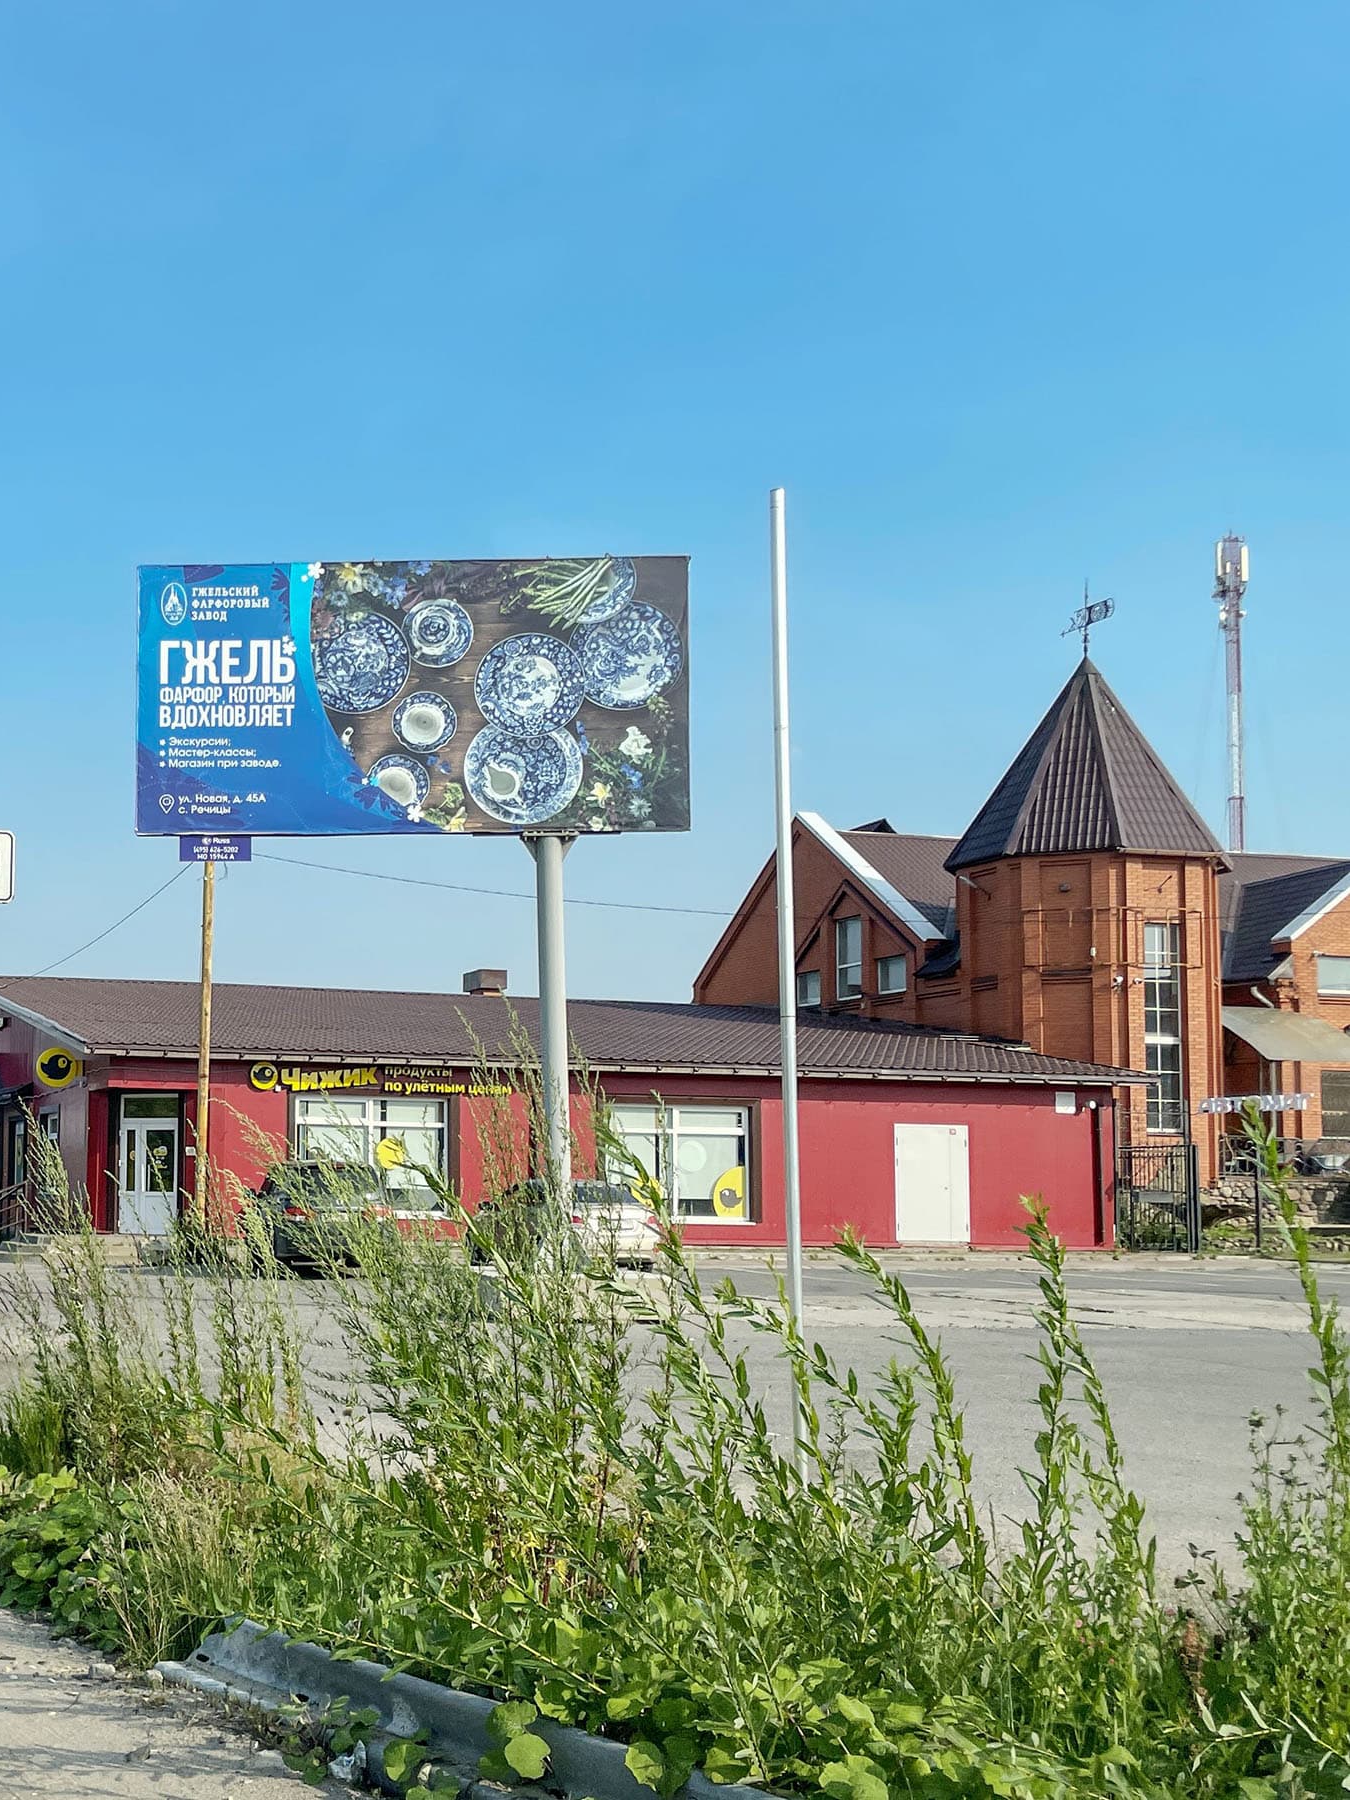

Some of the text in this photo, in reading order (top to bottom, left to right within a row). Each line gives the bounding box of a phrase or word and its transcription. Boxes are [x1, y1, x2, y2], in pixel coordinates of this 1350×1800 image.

[192, 585, 259, 597] ГЖЕЛЬСКИЙ
[191, 597, 270, 609] ФАРФОРОВЫЙ
[191, 611, 228, 622] ЗАВОД
[159, 639, 297, 685] ГЖЕЛЬ
[228, 683, 296, 703] КОТОРЫЙ
[159, 704, 296, 729] ВДОХНОВЛЯЕТ
[168, 737, 231, 748] Экскурсии;
[168, 748, 257, 759] Мастер-классы;
[168, 759, 282, 771] Магазин при заводе.
[178, 795, 192, 804] ул.
[246, 793, 267, 803] 45А
[190, 804, 231, 815] Речицы
[385, 1065, 452, 1079] продукты
[384, 1081, 402, 1092] по
[405, 1079, 465, 1095] улётным
